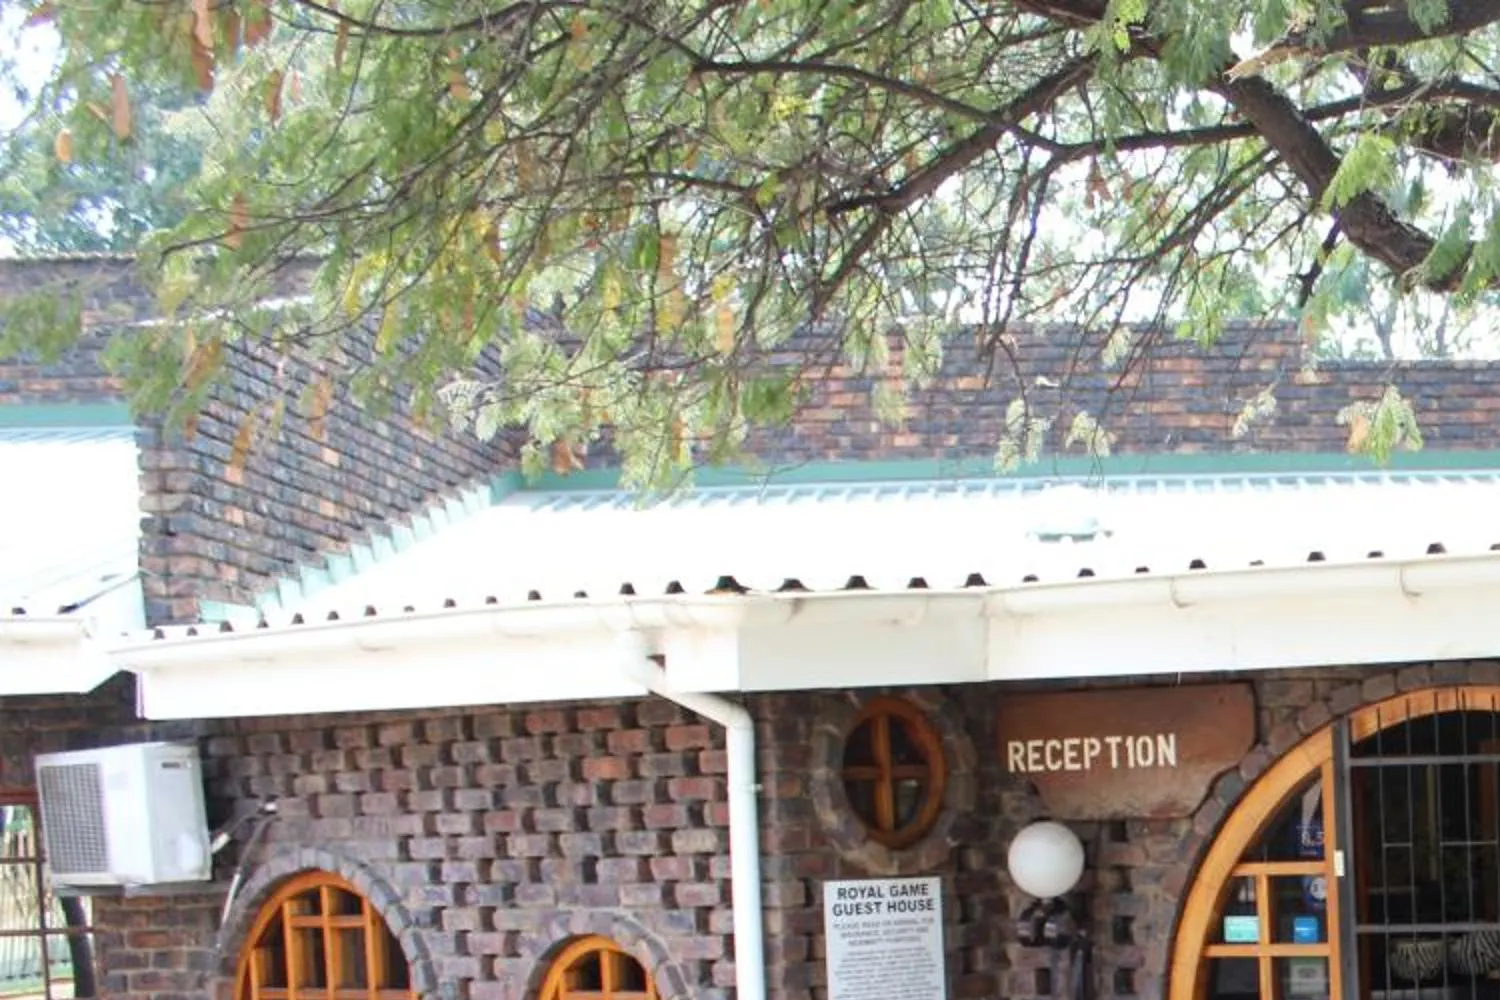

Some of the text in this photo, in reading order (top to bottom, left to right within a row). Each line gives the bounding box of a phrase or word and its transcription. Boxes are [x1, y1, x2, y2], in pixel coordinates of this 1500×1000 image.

[1007, 733, 1177, 773] RECEPTION
[837, 883, 929, 900] ROYAL GAME
[832, 899, 935, 916] GUEST HOUSE
